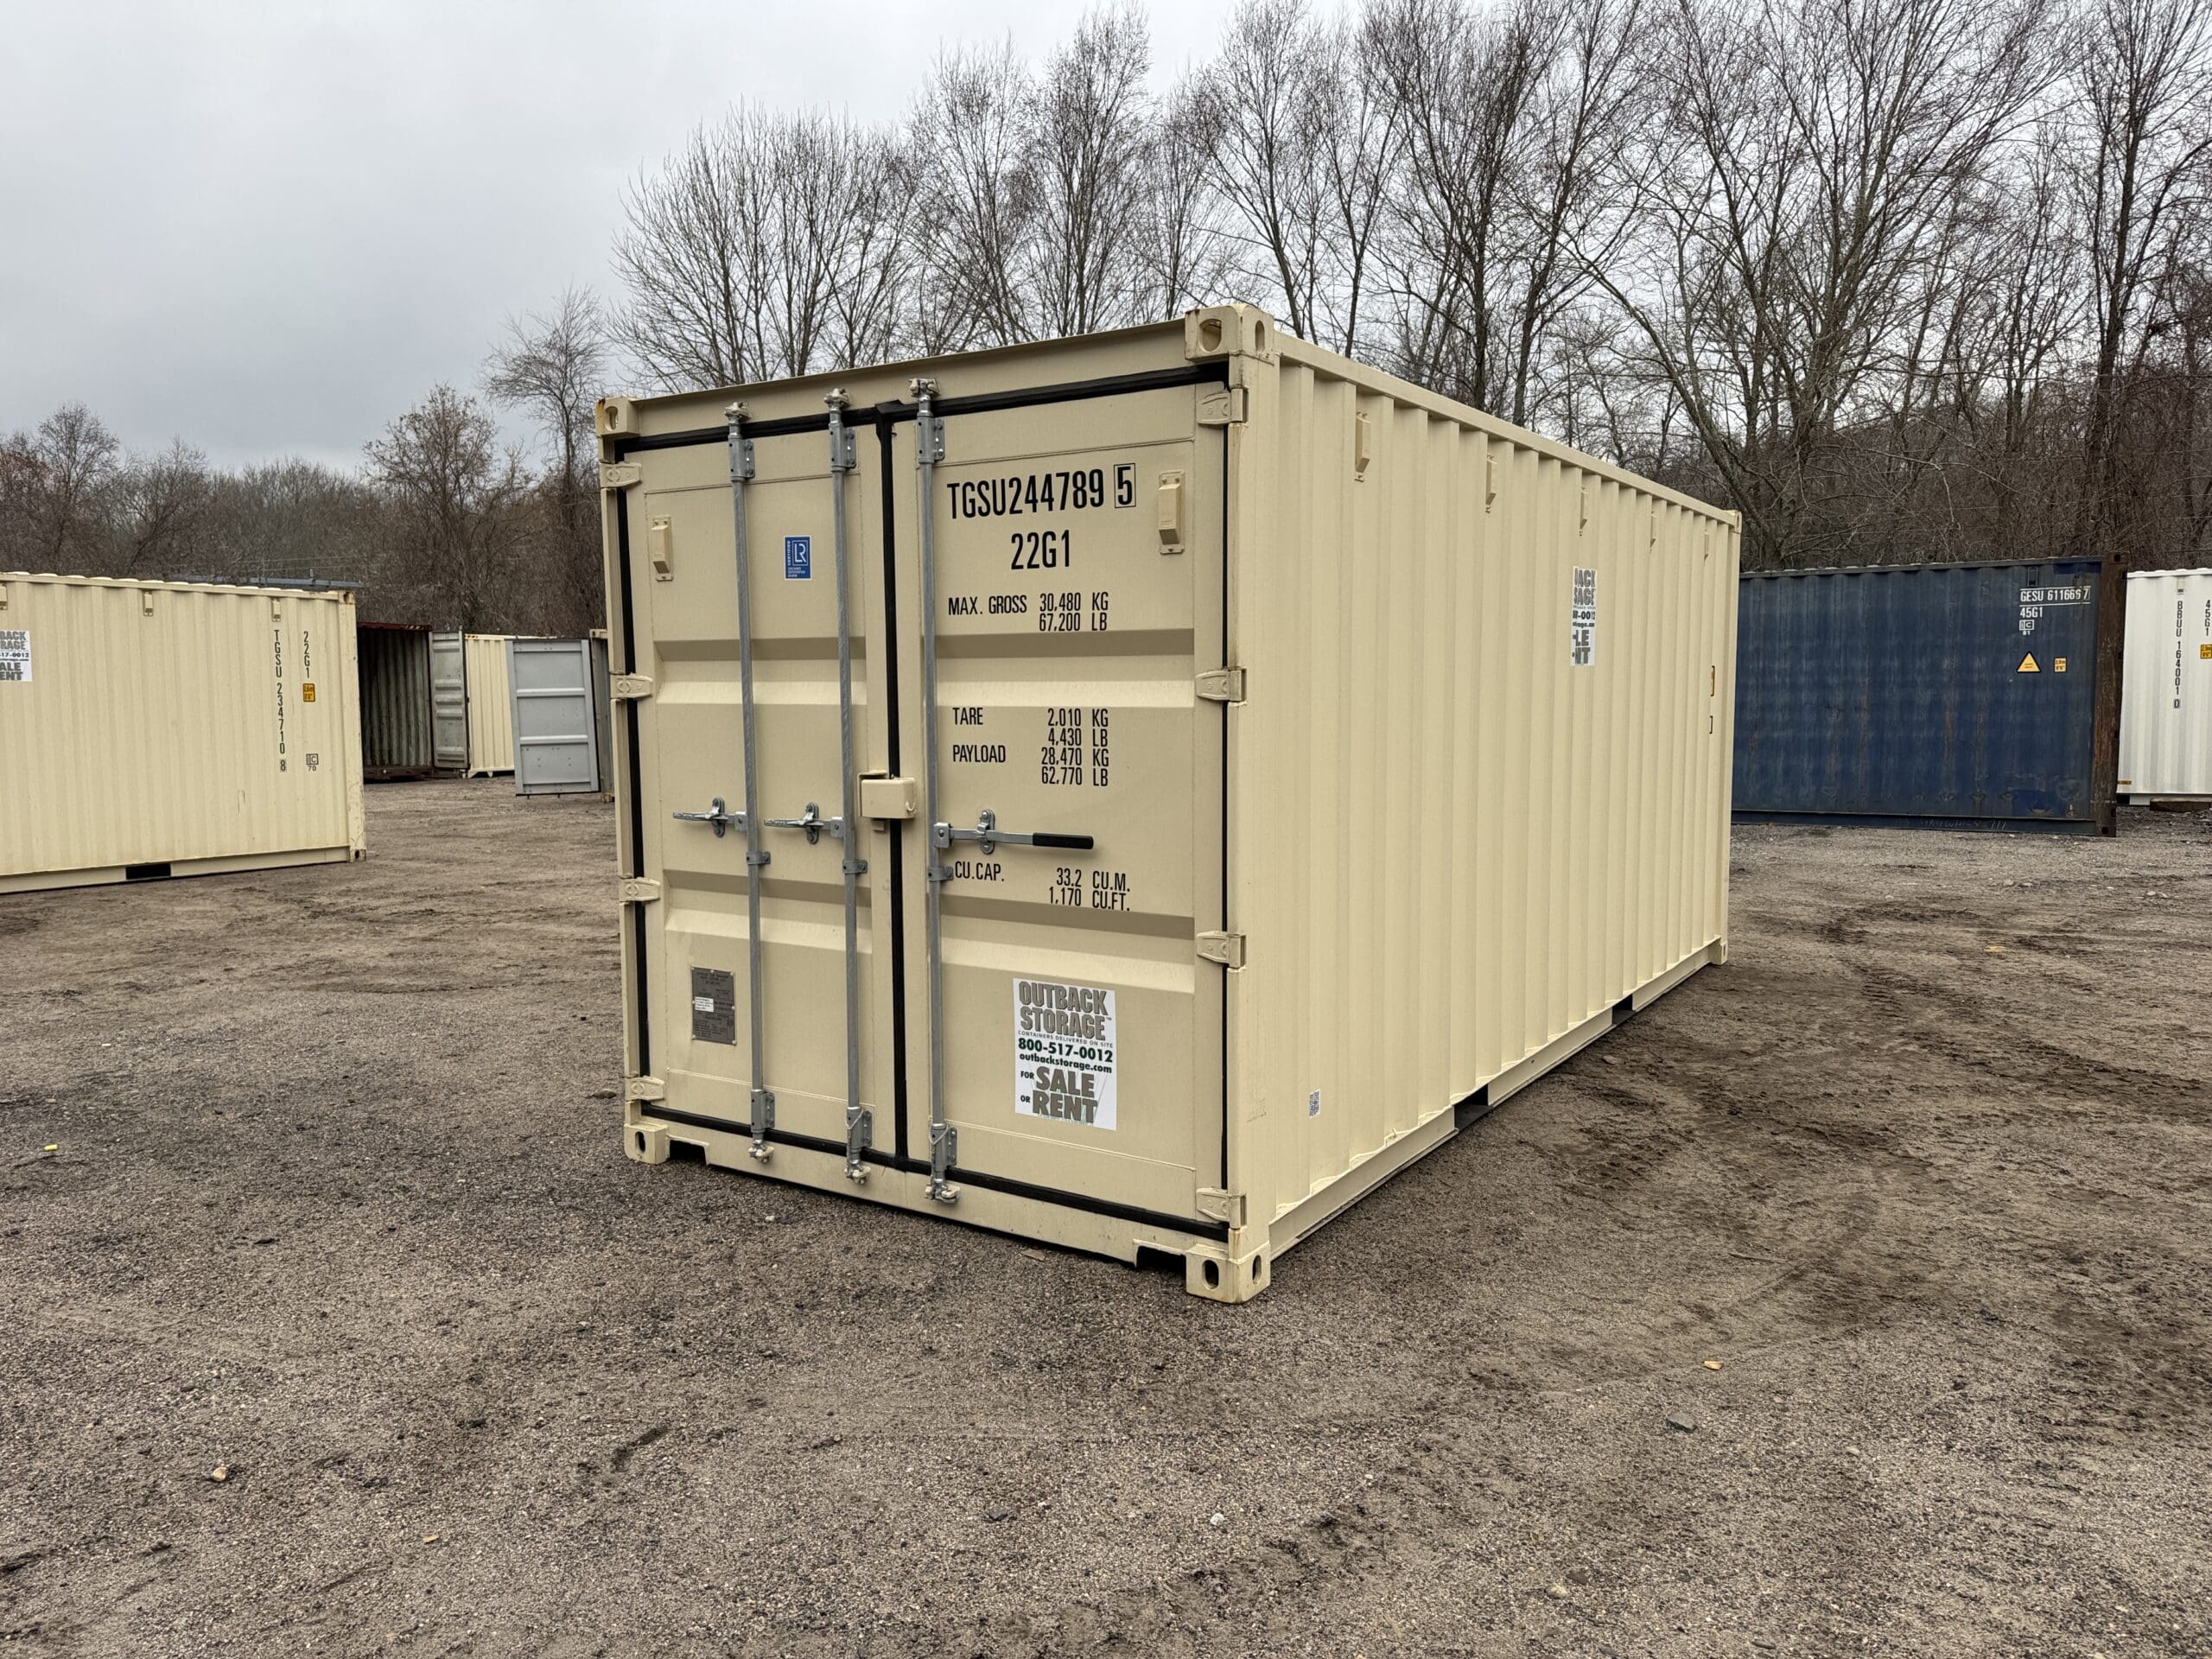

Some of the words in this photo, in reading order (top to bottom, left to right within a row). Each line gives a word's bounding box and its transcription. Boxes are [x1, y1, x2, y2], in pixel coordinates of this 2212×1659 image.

[947, 468, 1105, 519] TGSU244789
[1116, 465, 1133, 506] 5
[1010, 529, 1071, 570] 22G1
[948, 596, 983, 616] MAX.
[988, 594, 1027, 614] GROSS
[1039, 592, 1081, 613] 30,480
[1091, 591, 1109, 611] KG
[2020, 590, 2044, 602] GESU
[2047, 589, 2082, 601] 611666
[1039, 613, 1081, 632] 67,200
[1091, 612, 1108, 632] LB
[2019, 607, 2044, 619] 45G1
[273, 629, 283, 678] TGSU
[276, 682, 285, 754] 234710
[952, 707, 984, 726] TARE
[1047, 708, 1082, 728] 2,010
[1091, 708, 1109, 728] KG
[1048, 728, 1082, 747] 4,430
[1092, 728, 1109, 747] LB
[280, 760, 286, 772] 8
[952, 744, 1007, 763] PAYLOAD
[1041, 747, 1082, 767] 28,470
[1092, 748, 1109, 767] KG
[1041, 766, 1083, 786] 62,770
[1092, 768, 1109, 787] LB
[954, 861, 1005, 882] CU.CAP.
[1056, 868, 1082, 888] 33.2
[1091, 870, 1131, 893] CU.M.
[1048, 887, 1082, 907] 1,170
[1091, 890, 1131, 912] CU.FT.
[1018, 981, 1109, 1016] OUTBACK
[1020, 1006, 1106, 1041] STORAGE
[1018, 1030, 1054, 1039] CONTAINERS
[1055, 1035, 1087, 1045] DELIVERED
[1018, 1037, 1113, 1063] 800-517-0012
[1020, 1052, 1112, 1074] outbackstorage.com
[1020, 1071, 1034, 1080] FOR
[1036, 1065, 1095, 1098] SALE
[1033, 1090, 1098, 1123] RENT
